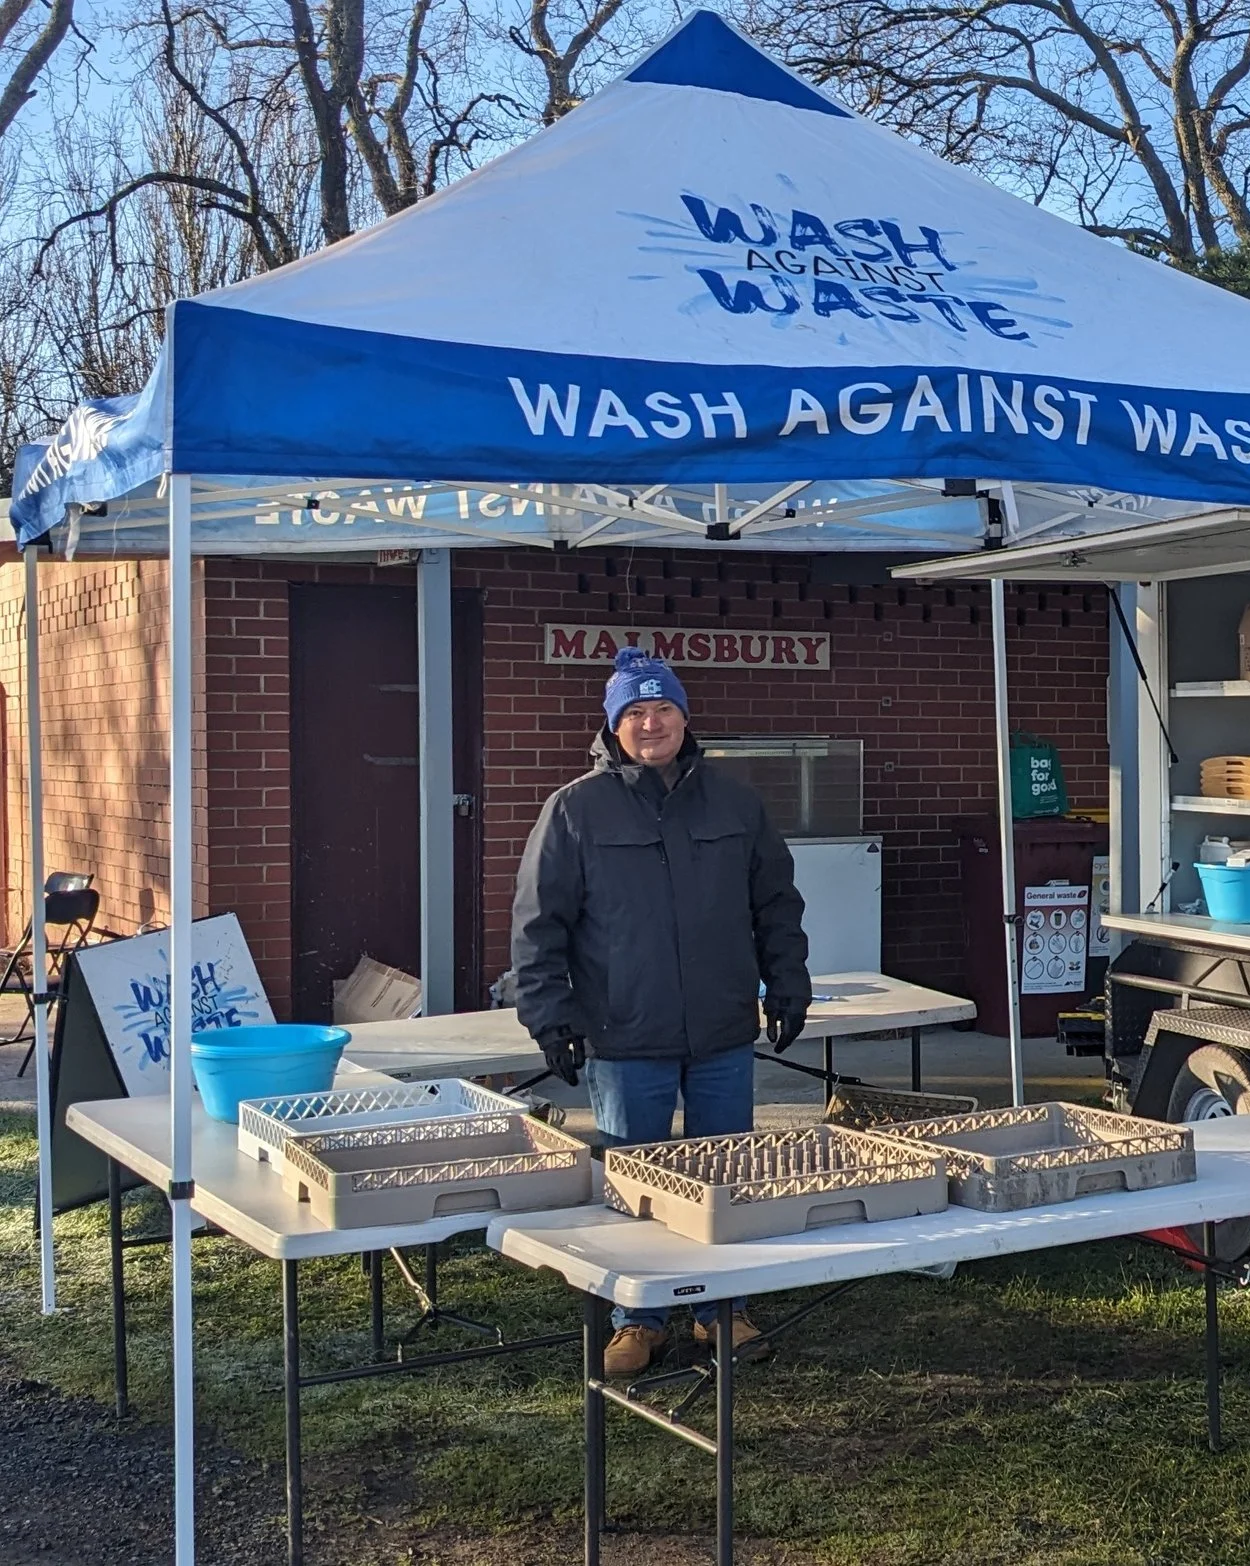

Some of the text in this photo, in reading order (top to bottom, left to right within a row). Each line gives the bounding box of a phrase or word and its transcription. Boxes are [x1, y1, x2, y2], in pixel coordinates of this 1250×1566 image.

[679, 192, 957, 272] WASH
[746, 247, 945, 293] AGAINST
[696, 268, 1032, 342] WASTE
[507, 376, 748, 440] WASH
[779, 373, 1099, 446] AGAINST
[551, 628, 827, 665] MALMSBURY
[1030, 769, 1050, 781] for
[1026, 891, 1077, 900] General waste
[130, 962, 221, 1012] WH
